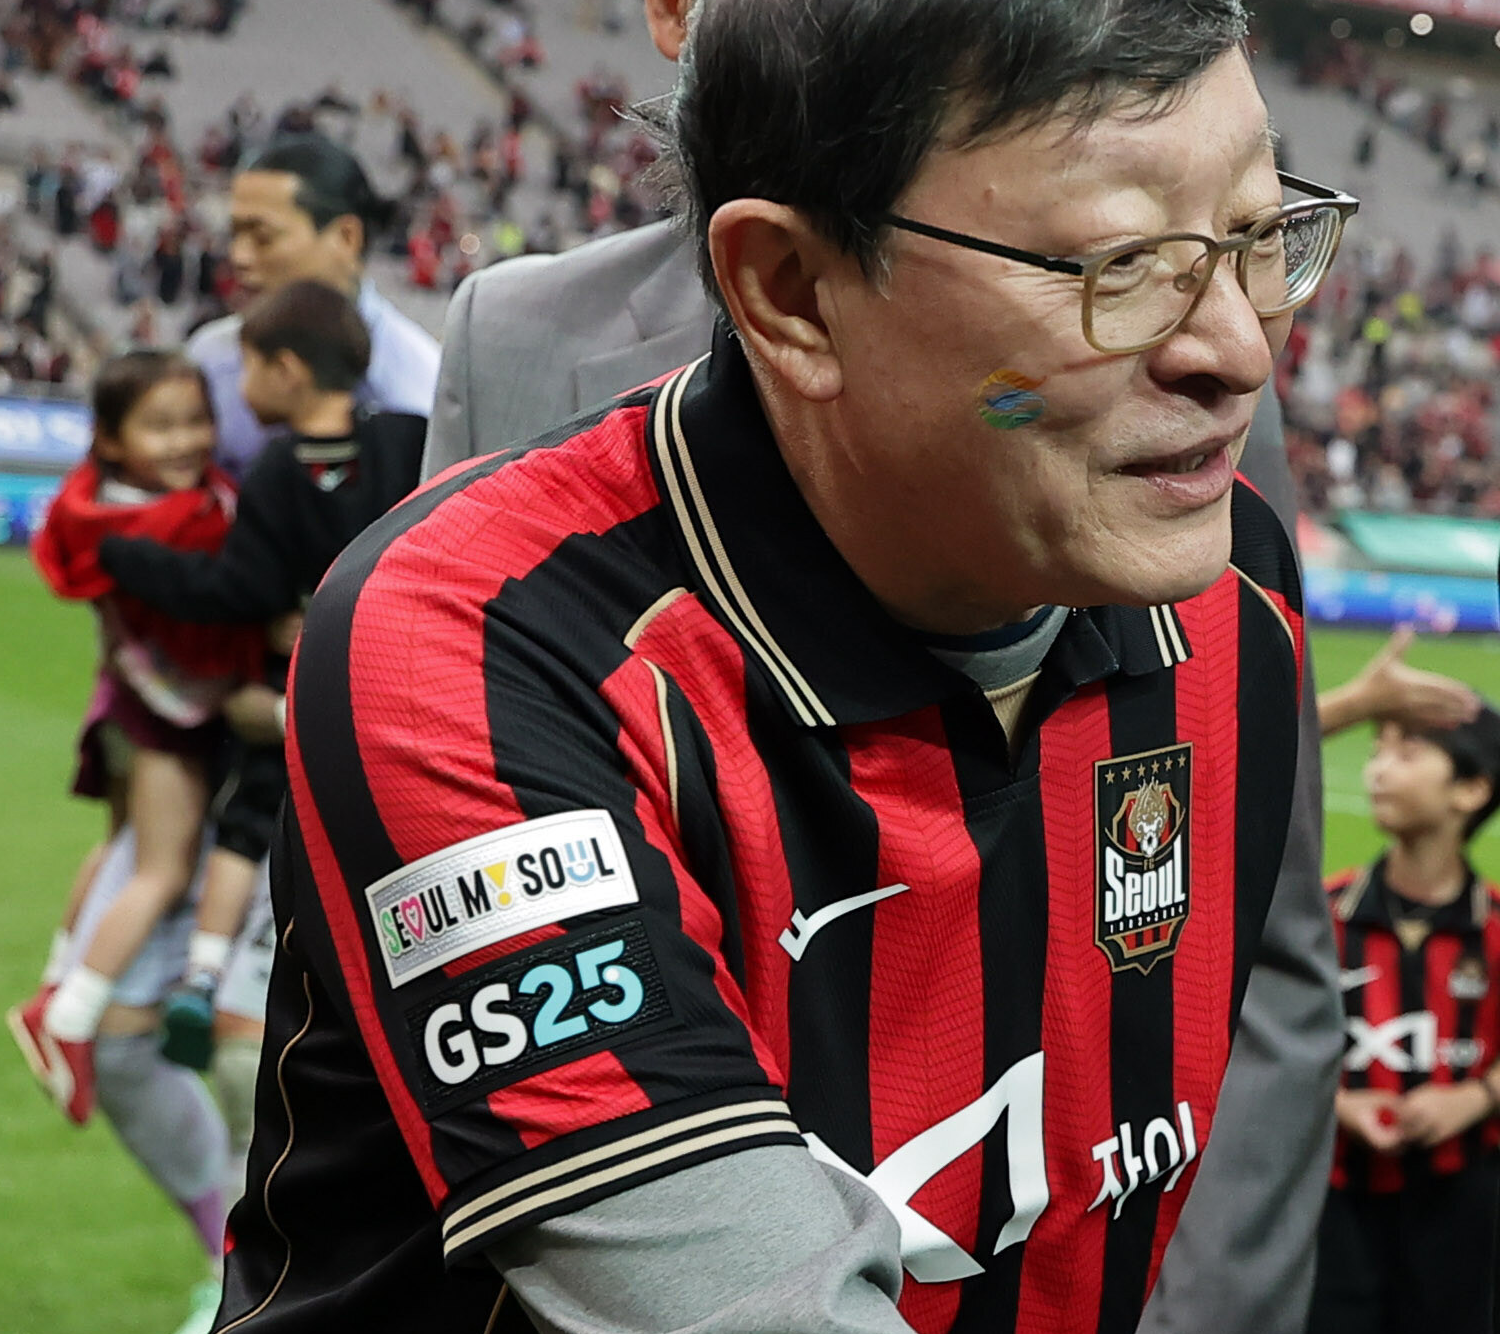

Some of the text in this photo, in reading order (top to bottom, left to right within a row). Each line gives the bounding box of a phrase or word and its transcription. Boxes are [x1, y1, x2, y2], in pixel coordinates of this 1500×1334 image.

[516, 836, 615, 897] SOUL
[1104, 832, 1187, 923] Seoul
[424, 939, 644, 1085] GS25
[1086, 1100, 1197, 1221] 자이
